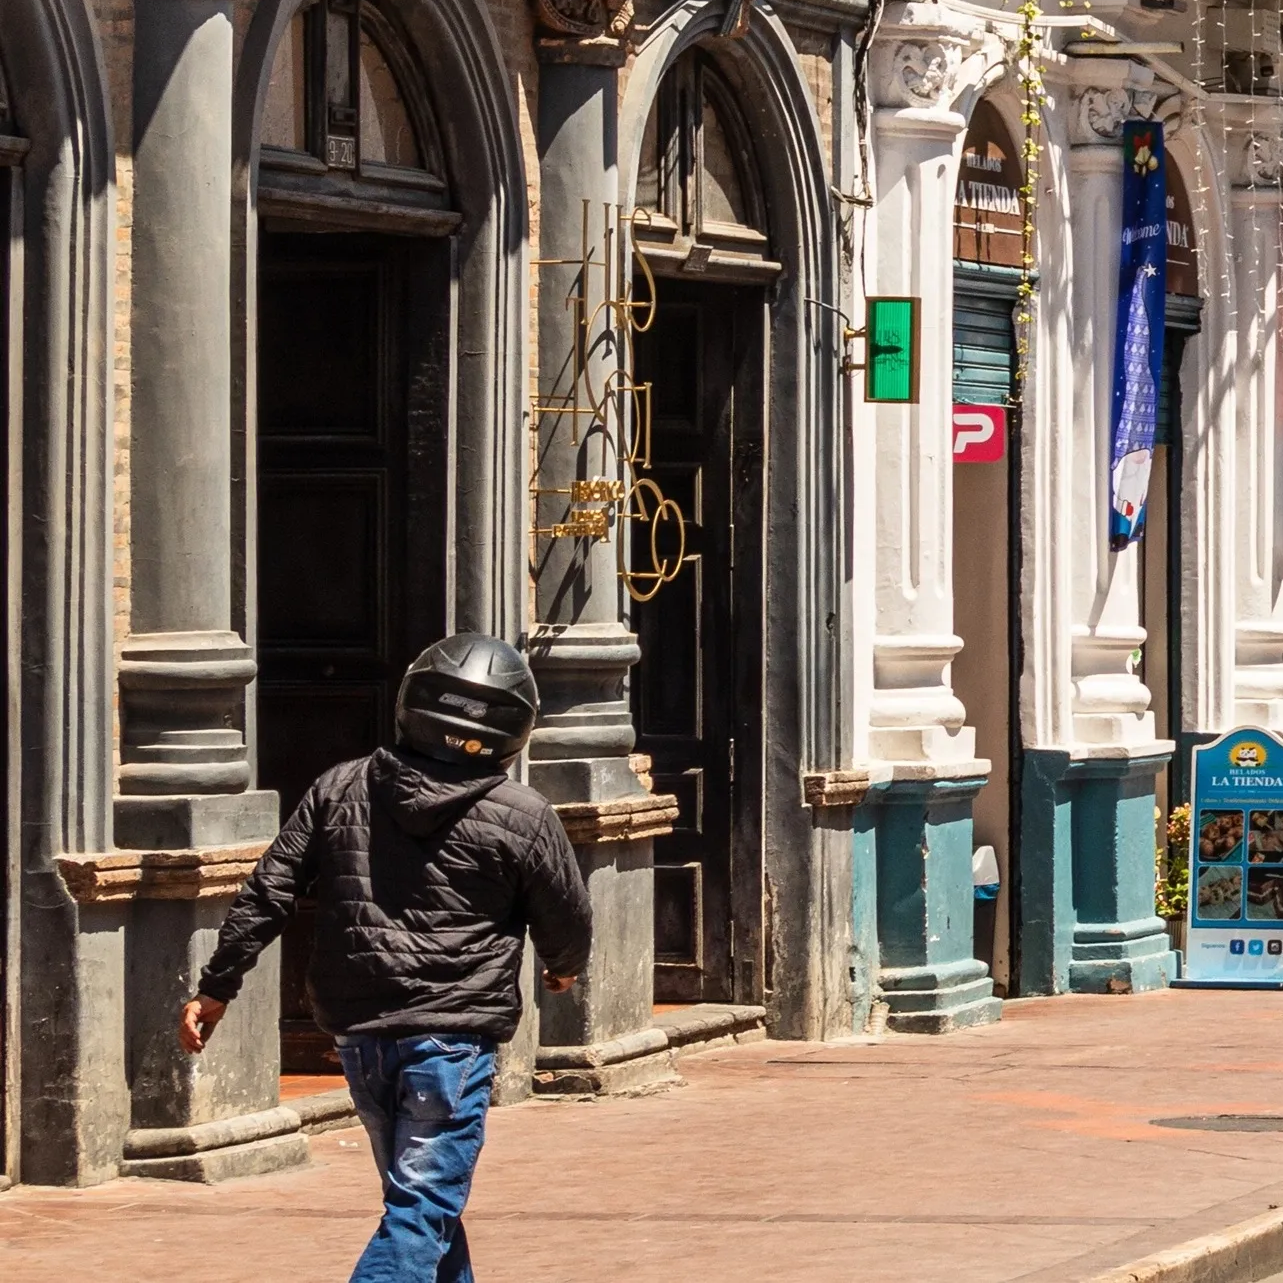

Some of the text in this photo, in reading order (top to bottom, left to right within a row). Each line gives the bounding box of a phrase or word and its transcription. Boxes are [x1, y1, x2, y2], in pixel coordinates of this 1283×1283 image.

[966, 153, 1002, 172] HELADOS
[968, 181, 1021, 216] TIENDA
[1165, 220, 1190, 248] NDA
[1211, 777, 1283, 787] LA TIENDA
